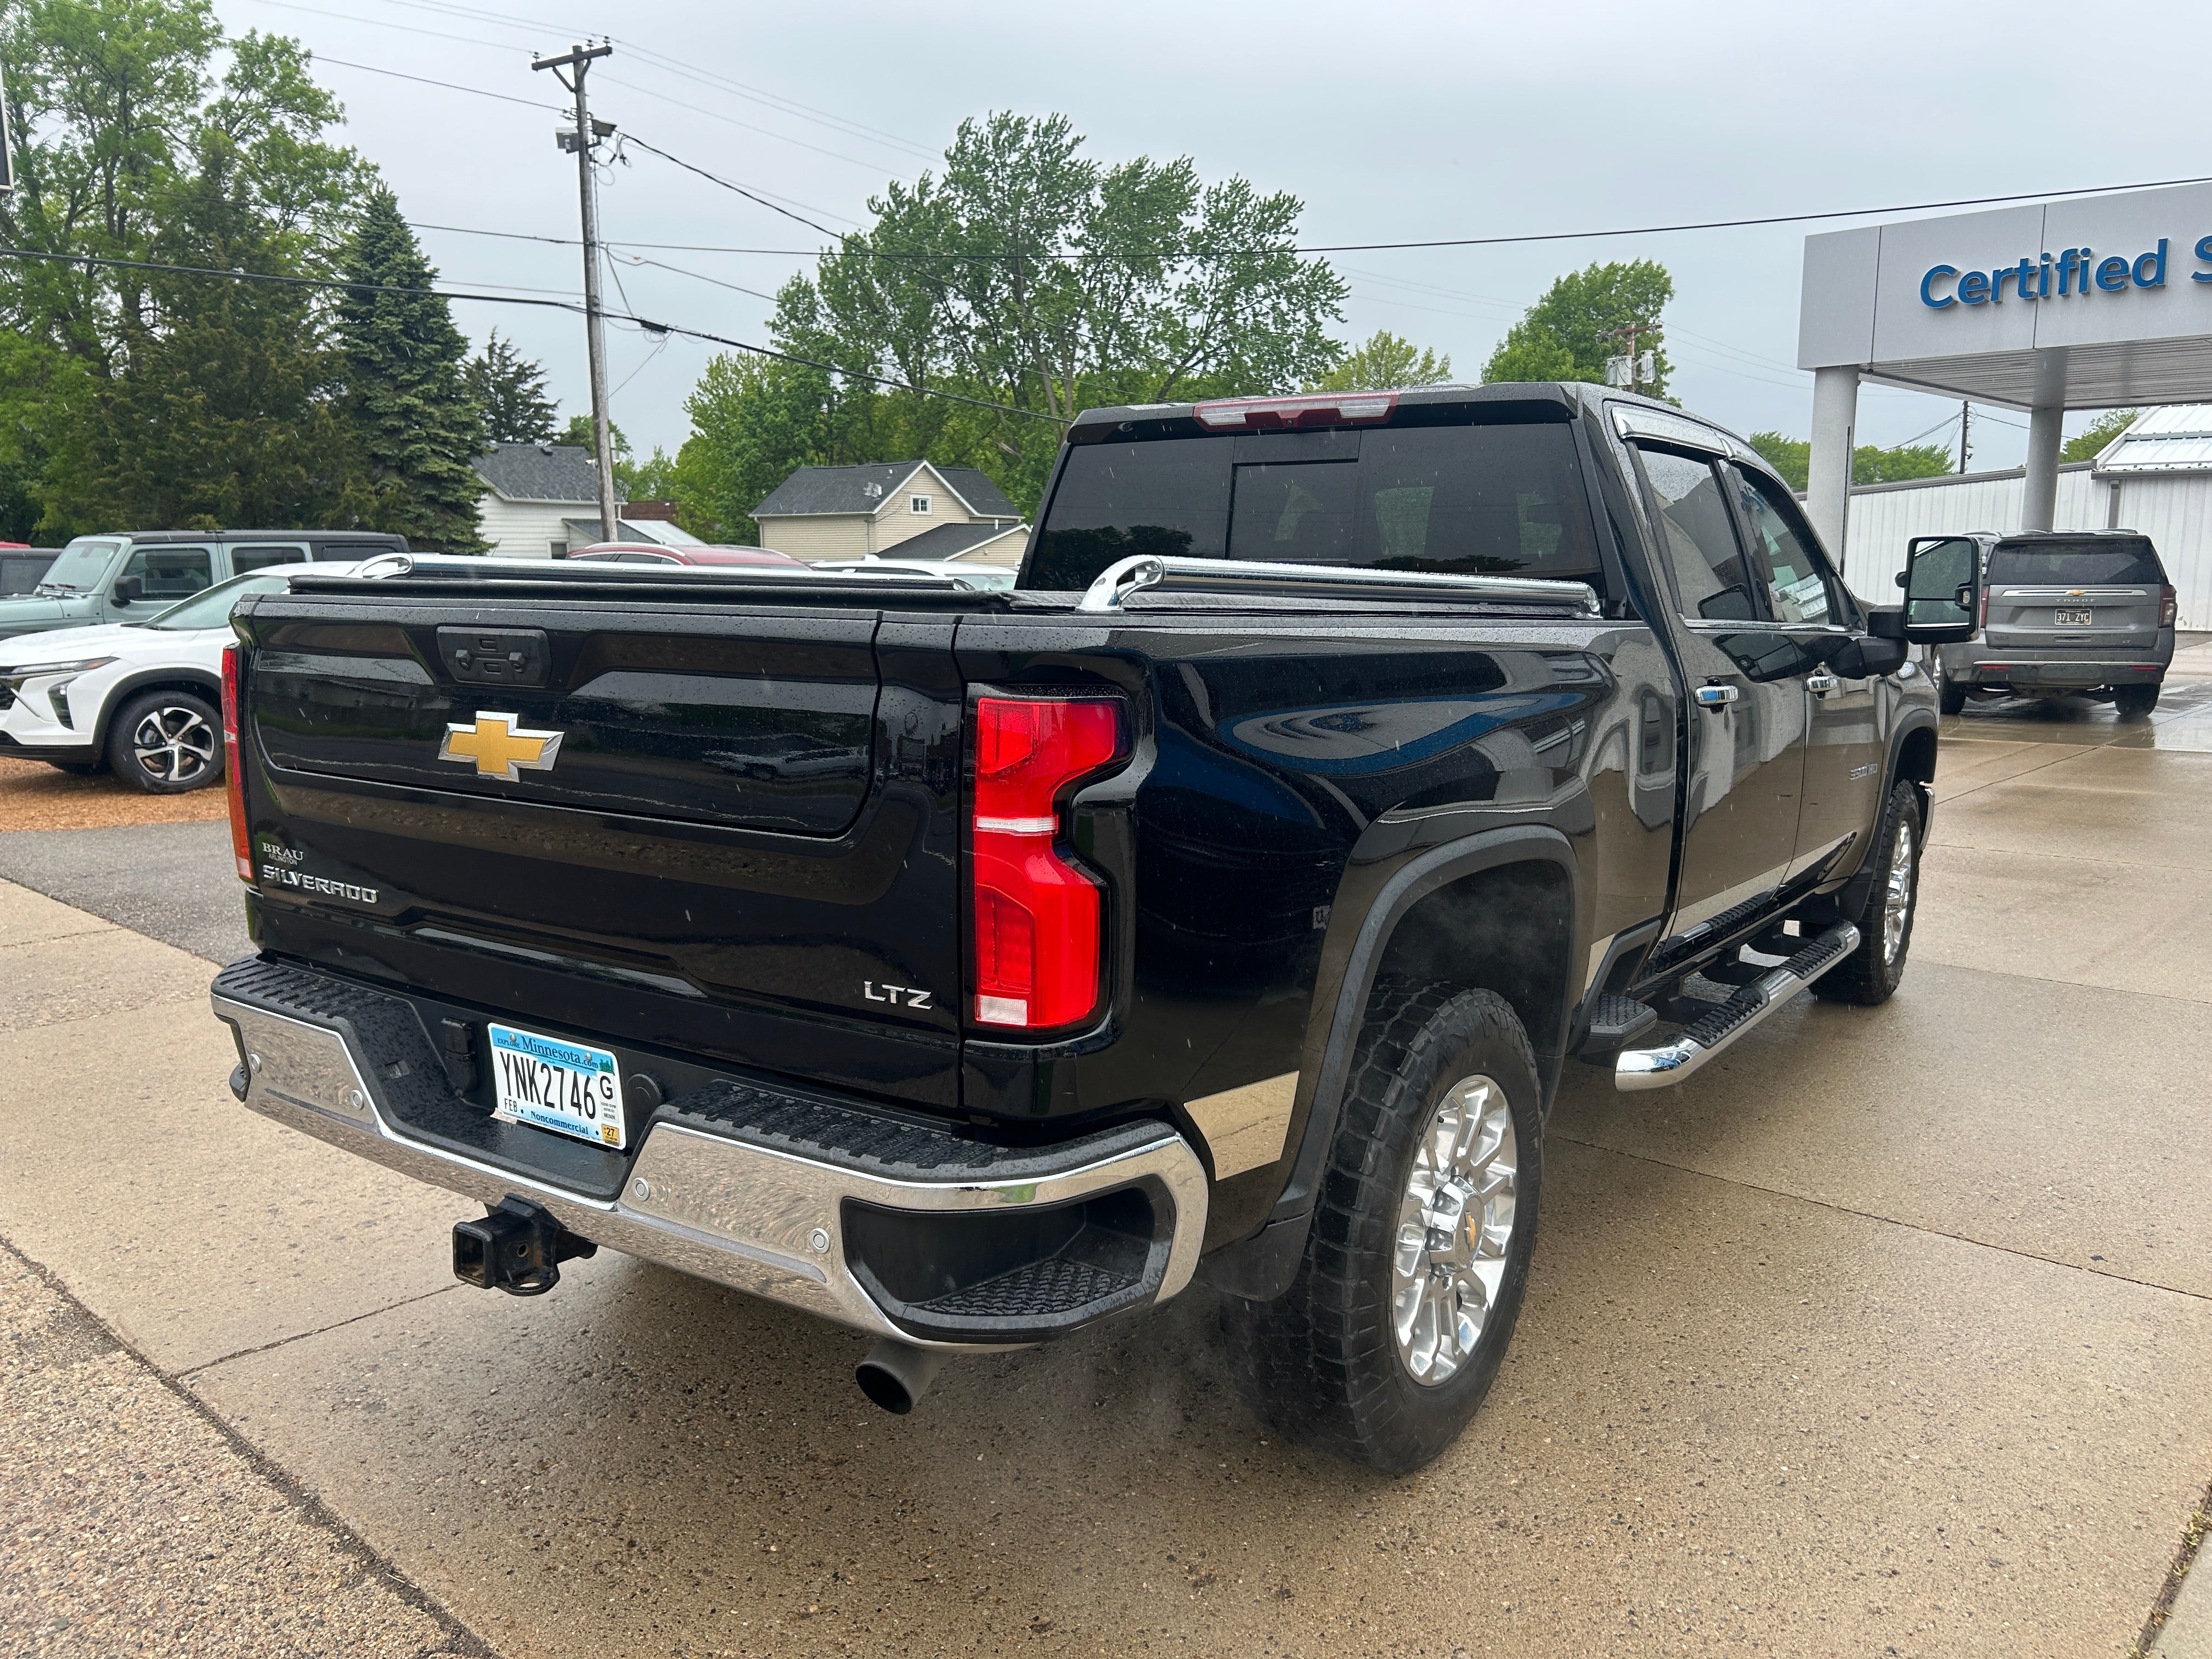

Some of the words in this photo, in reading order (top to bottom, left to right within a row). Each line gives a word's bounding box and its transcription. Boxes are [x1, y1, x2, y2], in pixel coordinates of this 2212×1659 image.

[1920, 238, 2170, 309] Certified
[2057, 613, 2070, 621] 371
[2075, 613, 2089, 621] ZYC
[262, 842, 303, 860] BRAU
[268, 853, 297, 866] ARLINGTON
[263, 864, 378, 904] SILVERADO
[864, 980, 932, 1009] LTZ
[497, 1037, 521, 1049] EXPLORE
[499, 1051, 596, 1120] YNK2746
[600, 1075, 613, 1100] G
[504, 1098, 517, 1112] FEB
[531, 1110, 589, 1135] Noncommercial
[606, 1127, 614, 1137] 27
